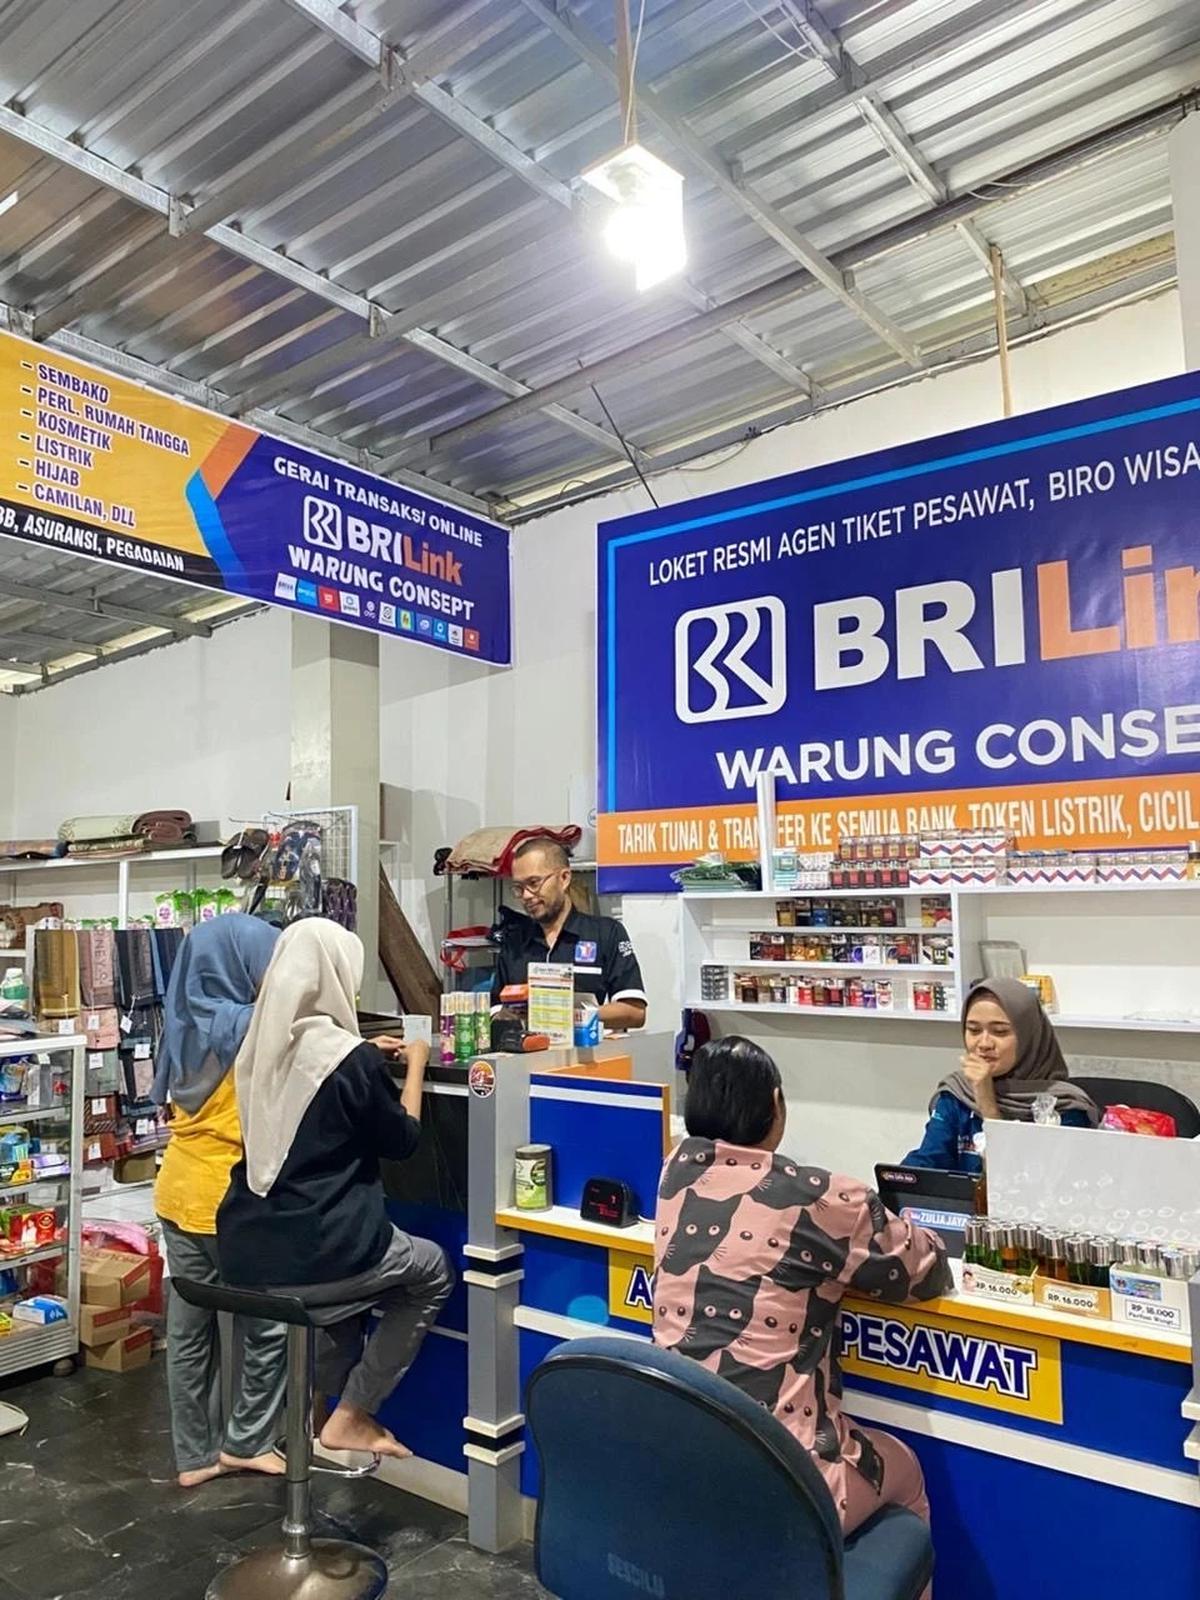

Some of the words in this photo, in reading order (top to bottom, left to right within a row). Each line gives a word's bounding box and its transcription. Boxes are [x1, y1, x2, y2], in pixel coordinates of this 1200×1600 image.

[39, 364, 109, 403] SEMBAKO
[36, 435, 92, 467] LISTRIK
[38, 387, 80, 416] PERL.
[85, 405, 135, 435] RUMAH
[139, 424, 189, 456] TANGGA
[38, 411, 111, 450] KOSMETIK
[35, 484, 106, 521] CAMILAN,
[112, 506, 135, 527] DLL
[36, 459, 79, 486] HIJAB
[274, 457, 329, 490] GERAI
[334, 478, 426, 525] TRANSAKSI
[429, 515, 483, 547] ONLINE
[23, 514, 102, 555] ASURANSI,
[107, 538, 184, 572] PEGADAIAN
[650, 551, 707, 586] LOKET
[713, 536, 771, 572] RESMI
[778, 522, 835, 559] AGEN
[842, 506, 905, 544] TIKET
[913, 478, 1034, 530] PESAWAT,
[1049, 461, 1115, 501] BIRO
[1124, 442, 1200, 485] WISA
[288, 544, 383, 593] WARUNG
[389, 576, 474, 620] CONSEPT
[347, 515, 463, 586] BRILink
[715, 730, 956, 790] WARUNG
[975, 704, 1200, 769] CONSE
[618, 822, 656, 854] TARIK
[660, 819, 703, 852] TUNAI
[708, 819, 719, 850] &
[723, 813, 806, 850] TRANFER
[811, 812, 832, 847] KE
[837, 808, 901, 836] SEMUA
[906, 804, 957, 835] BANK
[968, 800, 1036, 838] TOKEN
[1042, 794, 1132, 839] LISTRIK,
[1139, 790, 1200, 832] CICIL
[841, 1314, 1035, 1398] PESAWAT
